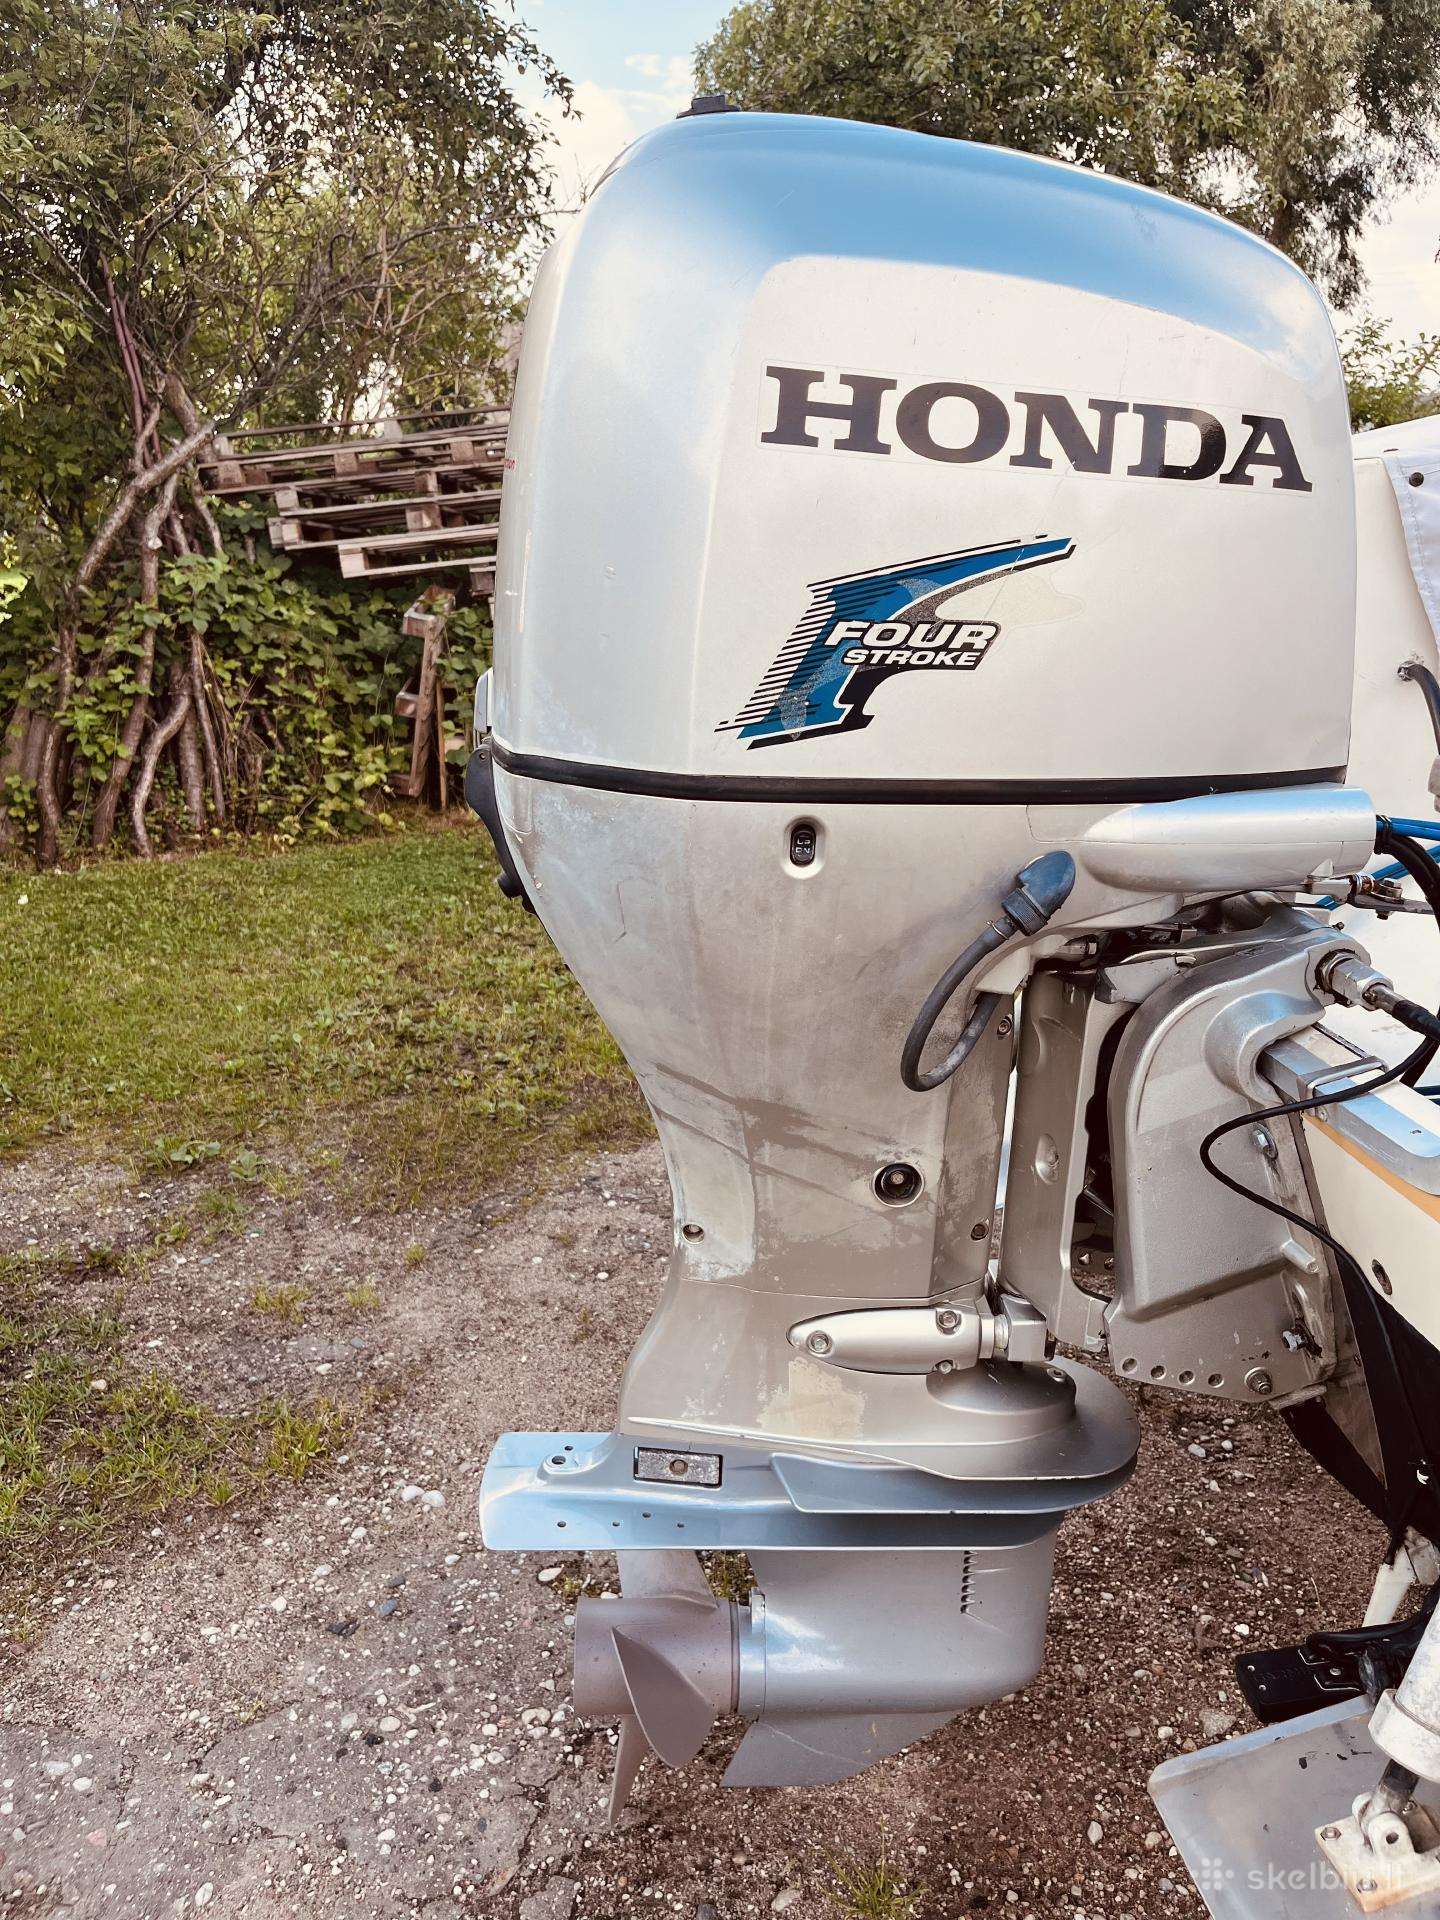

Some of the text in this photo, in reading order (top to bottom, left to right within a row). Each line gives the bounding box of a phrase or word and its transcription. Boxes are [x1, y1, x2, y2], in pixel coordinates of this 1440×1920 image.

[760, 366, 1312, 492] HONDA
[824, 621, 997, 649] FOUR
[843, 649, 981, 666] STROKE
